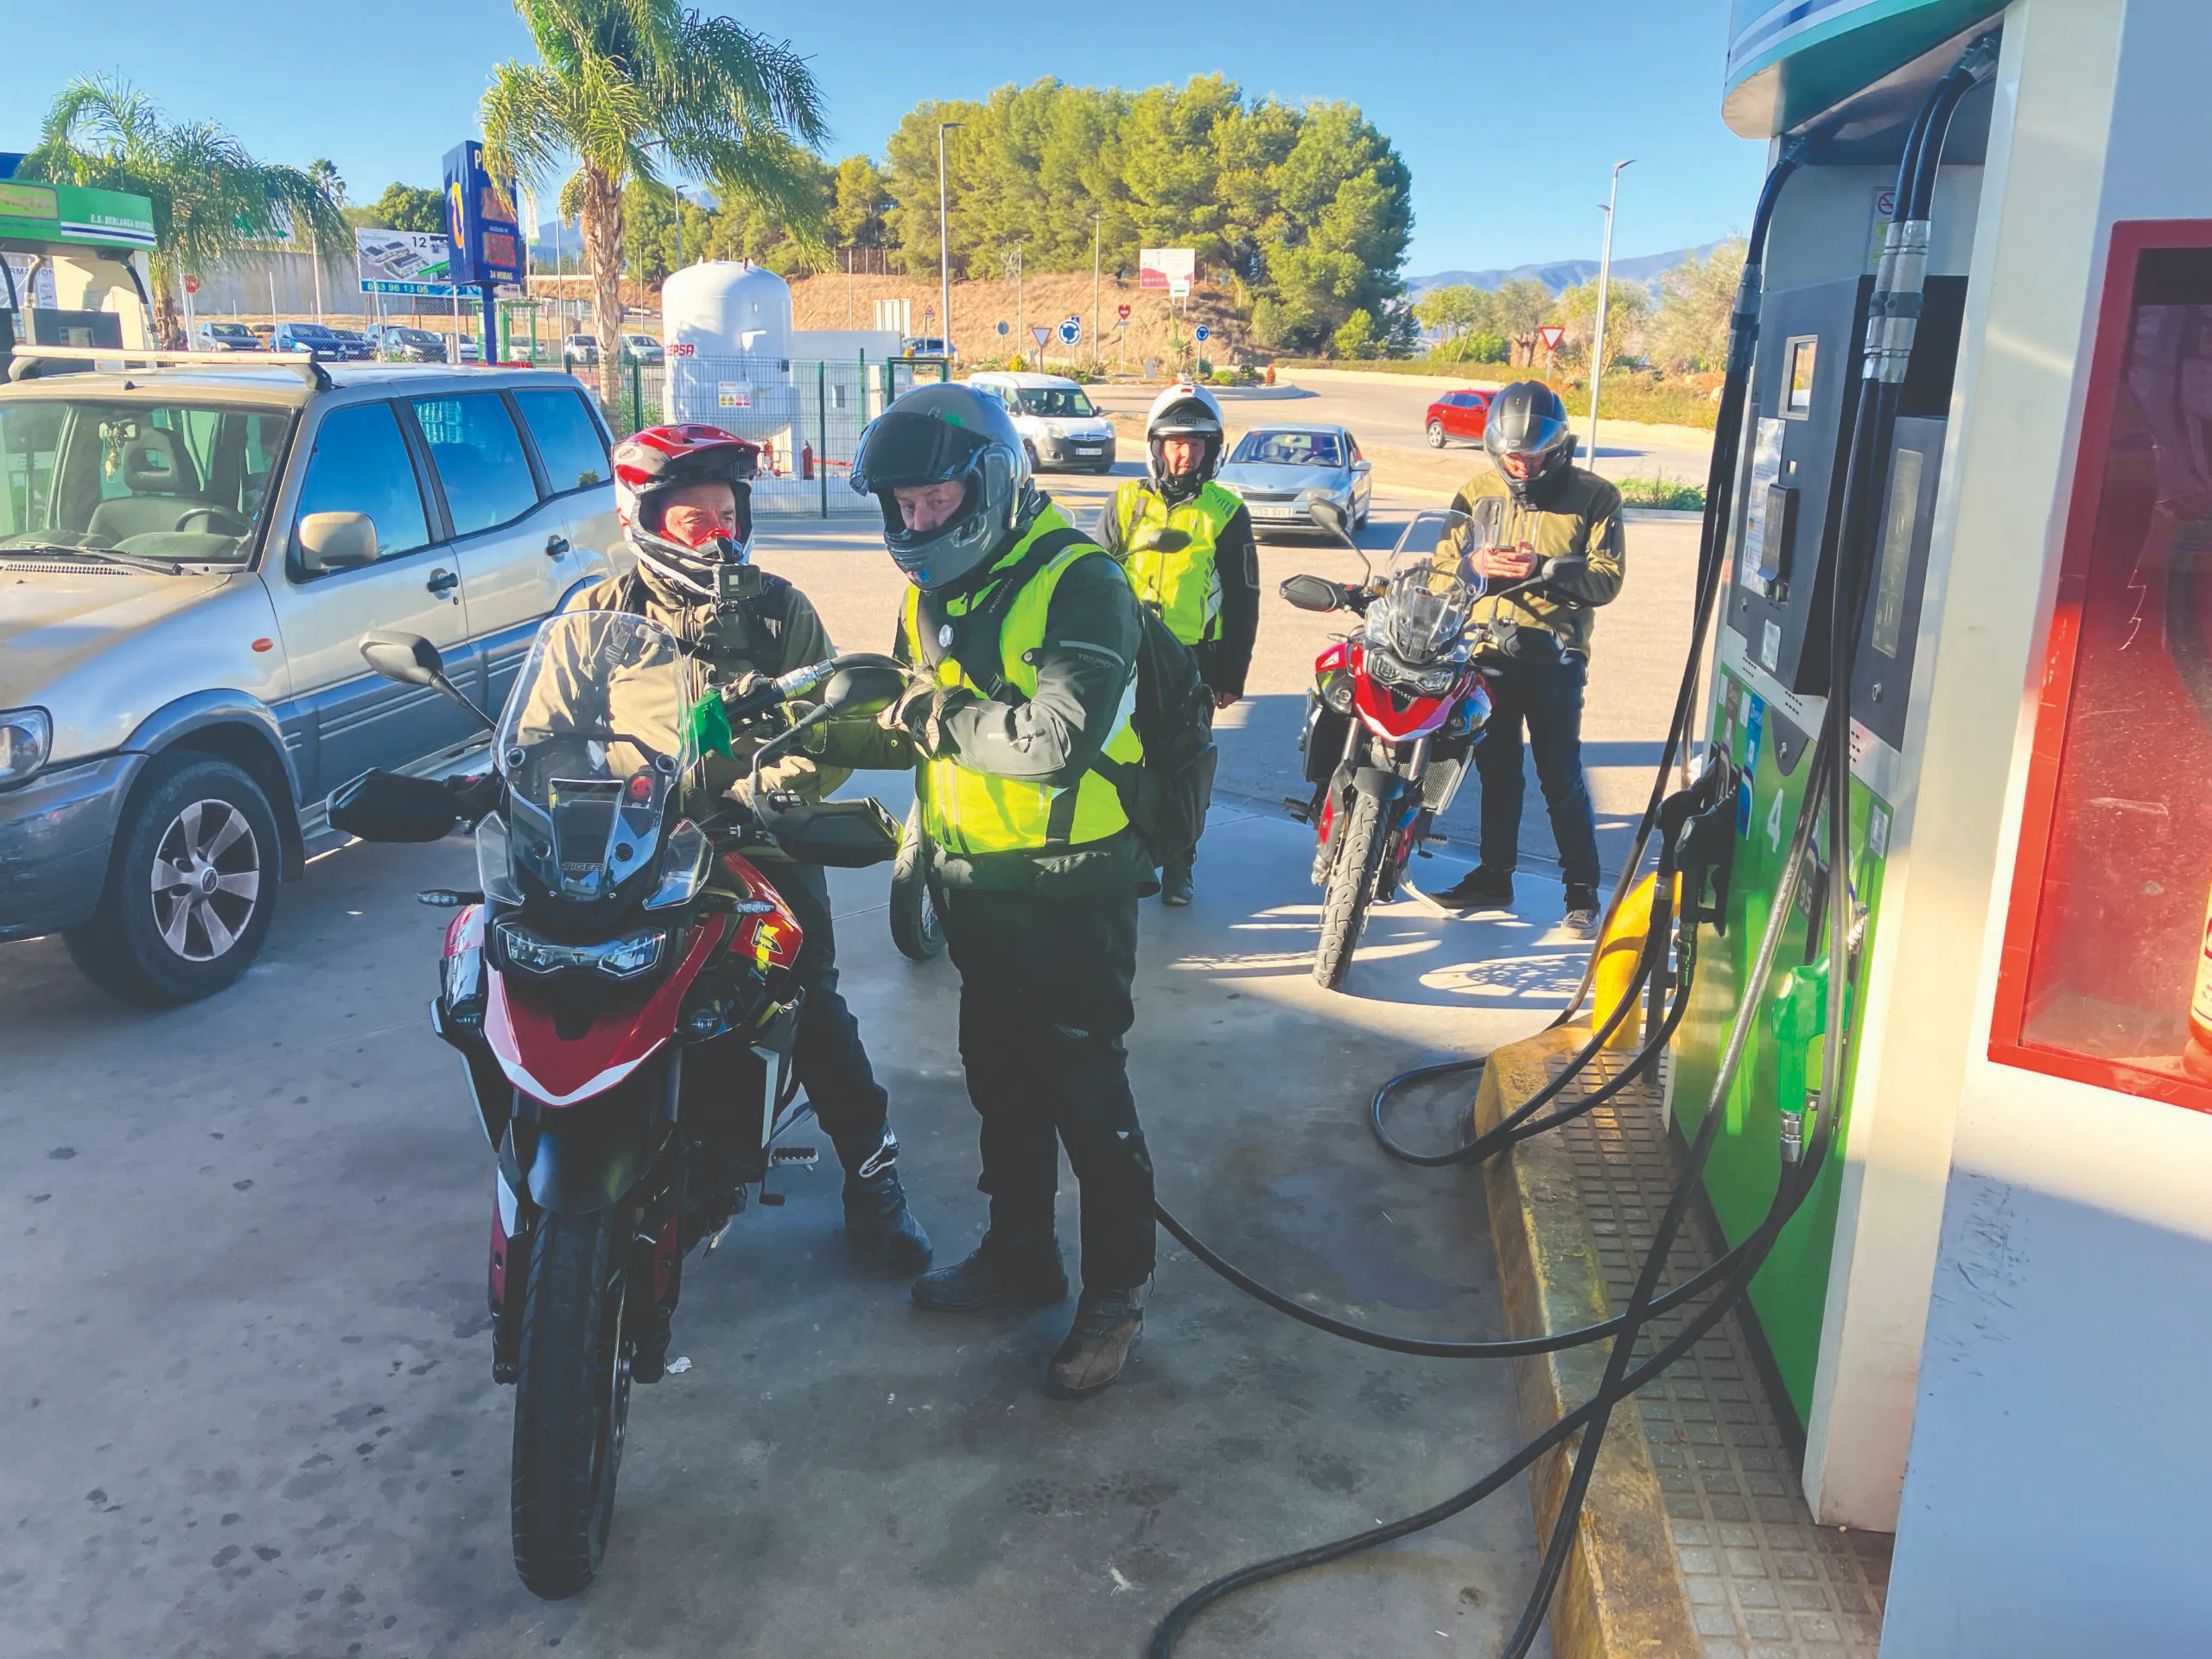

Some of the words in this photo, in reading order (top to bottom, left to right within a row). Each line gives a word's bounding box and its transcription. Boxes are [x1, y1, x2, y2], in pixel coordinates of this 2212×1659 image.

[412, 236, 427, 248] 12
[1077, 653, 1115, 668] TRIUMPH
[1767, 787, 1784, 854] 4
[562, 861, 604, 872] TIGER
[1799, 878, 1813, 915] 95
